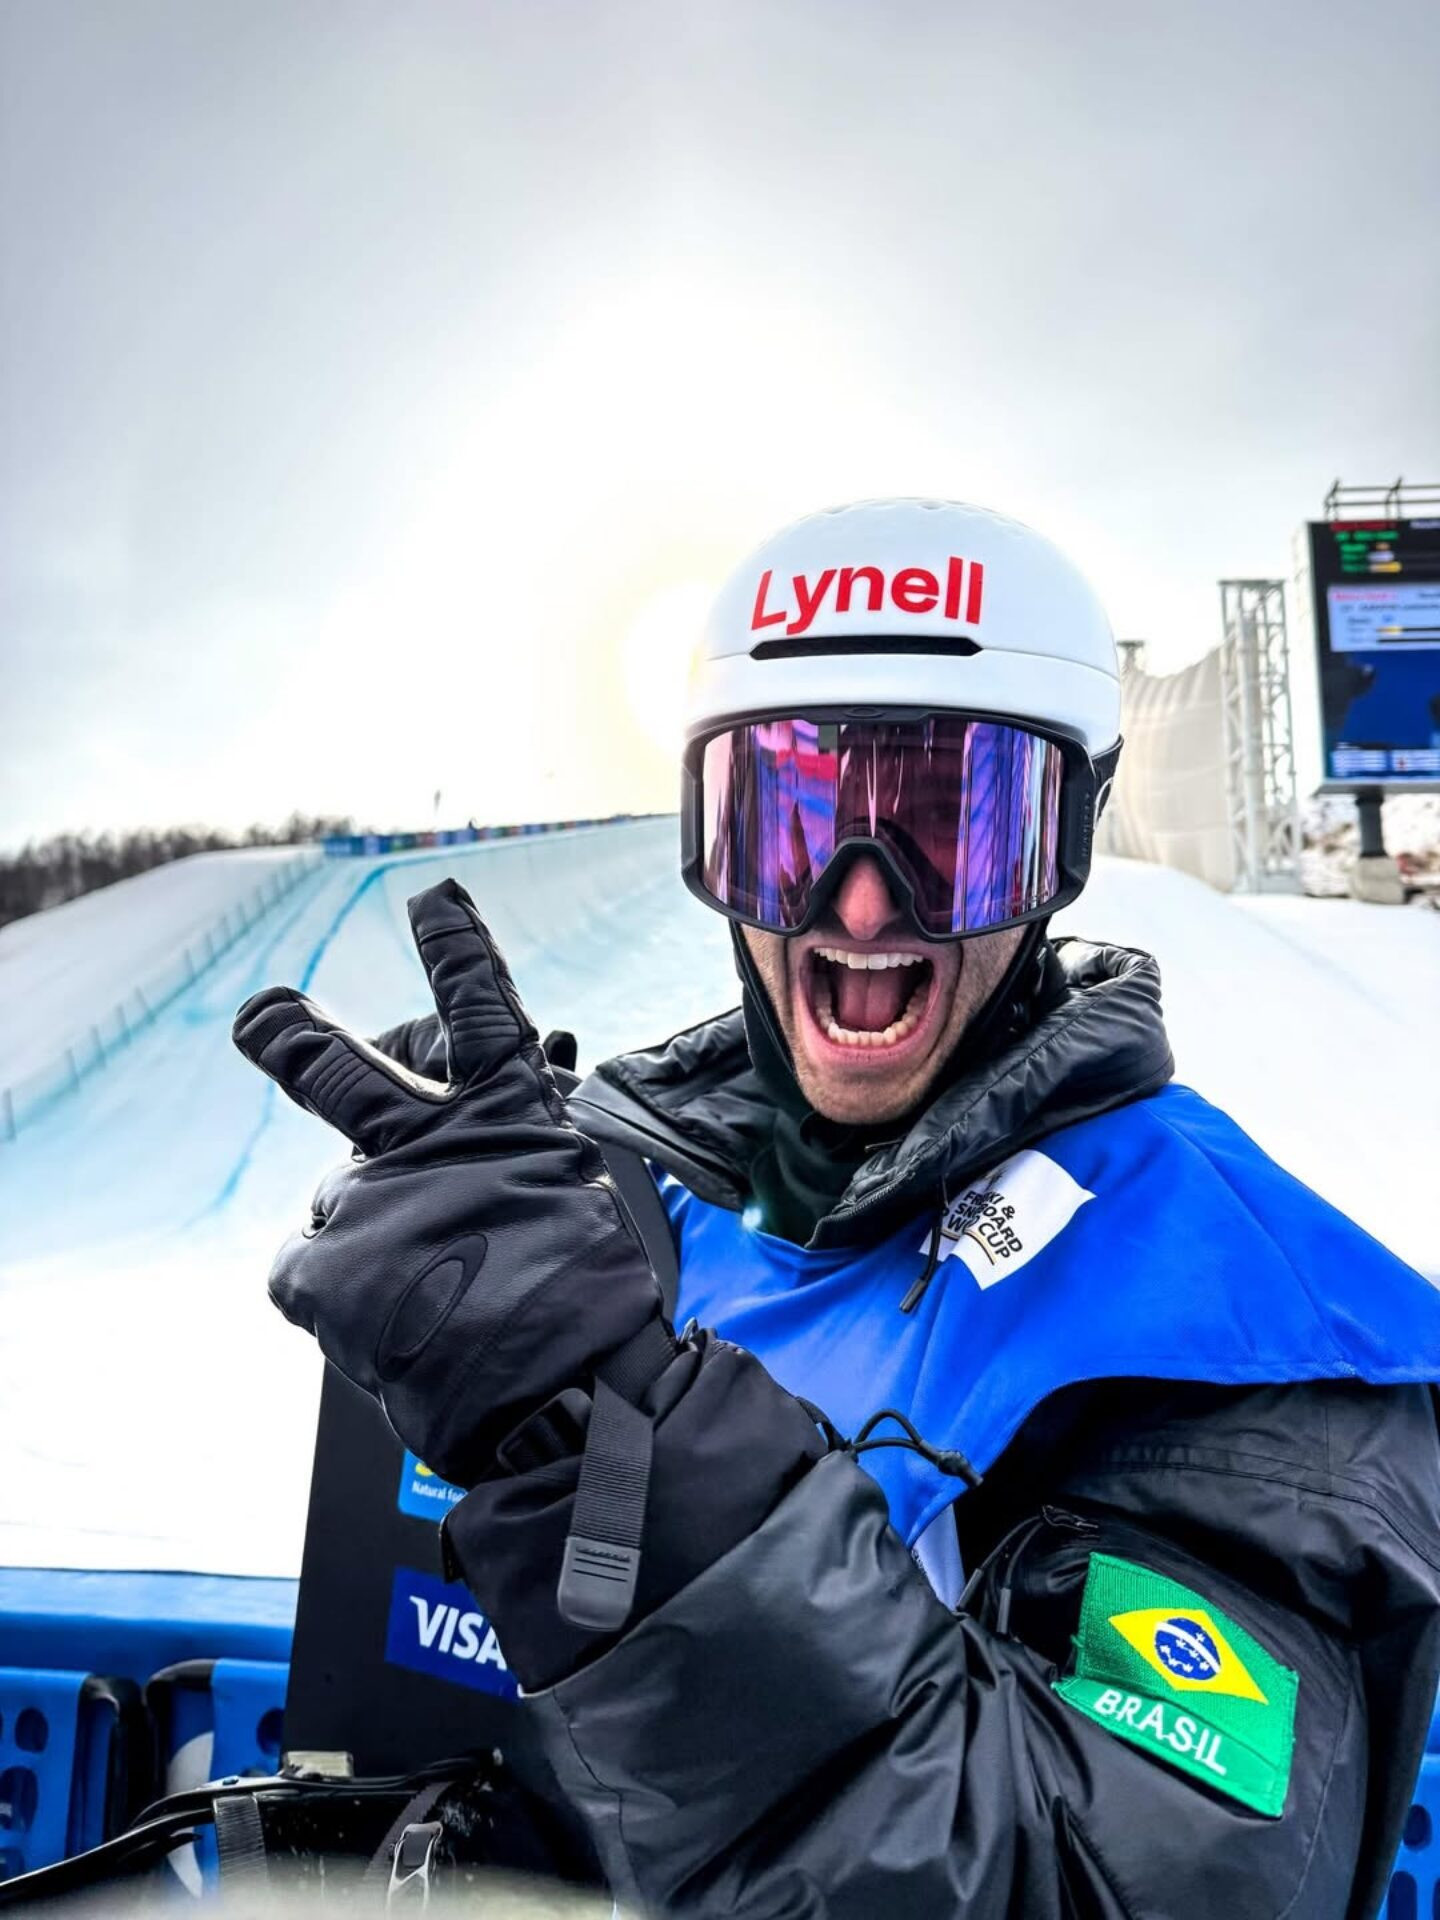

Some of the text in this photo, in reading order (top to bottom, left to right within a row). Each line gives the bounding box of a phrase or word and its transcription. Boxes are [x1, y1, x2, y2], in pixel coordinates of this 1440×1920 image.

[751, 555, 984, 636] Lynell
[978, 1222, 1011, 1259] CUP
[1001, 1205, 1016, 1220] &
[412, 1480, 446, 1500] Natural
[409, 1595, 508, 1671] VISA
[1093, 1689, 1227, 1776] BRASIL
